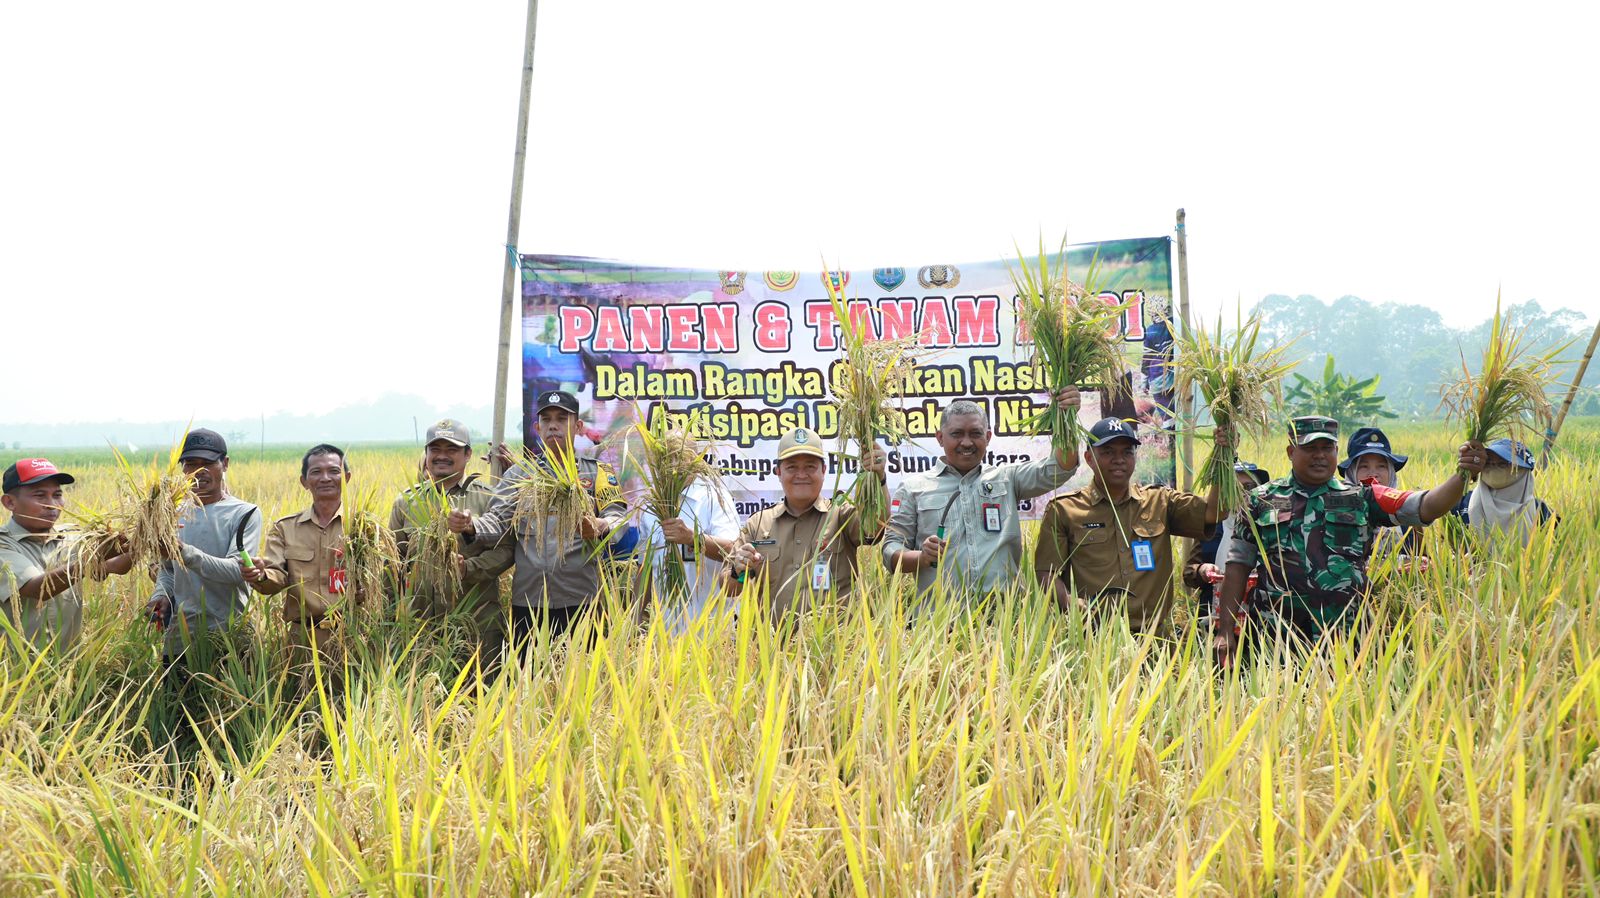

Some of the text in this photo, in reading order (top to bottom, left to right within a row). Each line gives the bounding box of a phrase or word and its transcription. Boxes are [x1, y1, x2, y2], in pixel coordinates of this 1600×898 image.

[559, 301, 738, 353] PANEN
[754, 301, 792, 352] &
[805, 296, 1000, 350] TANAM
[595, 363, 697, 398] Dalam
[703, 363, 823, 401] Rangka
